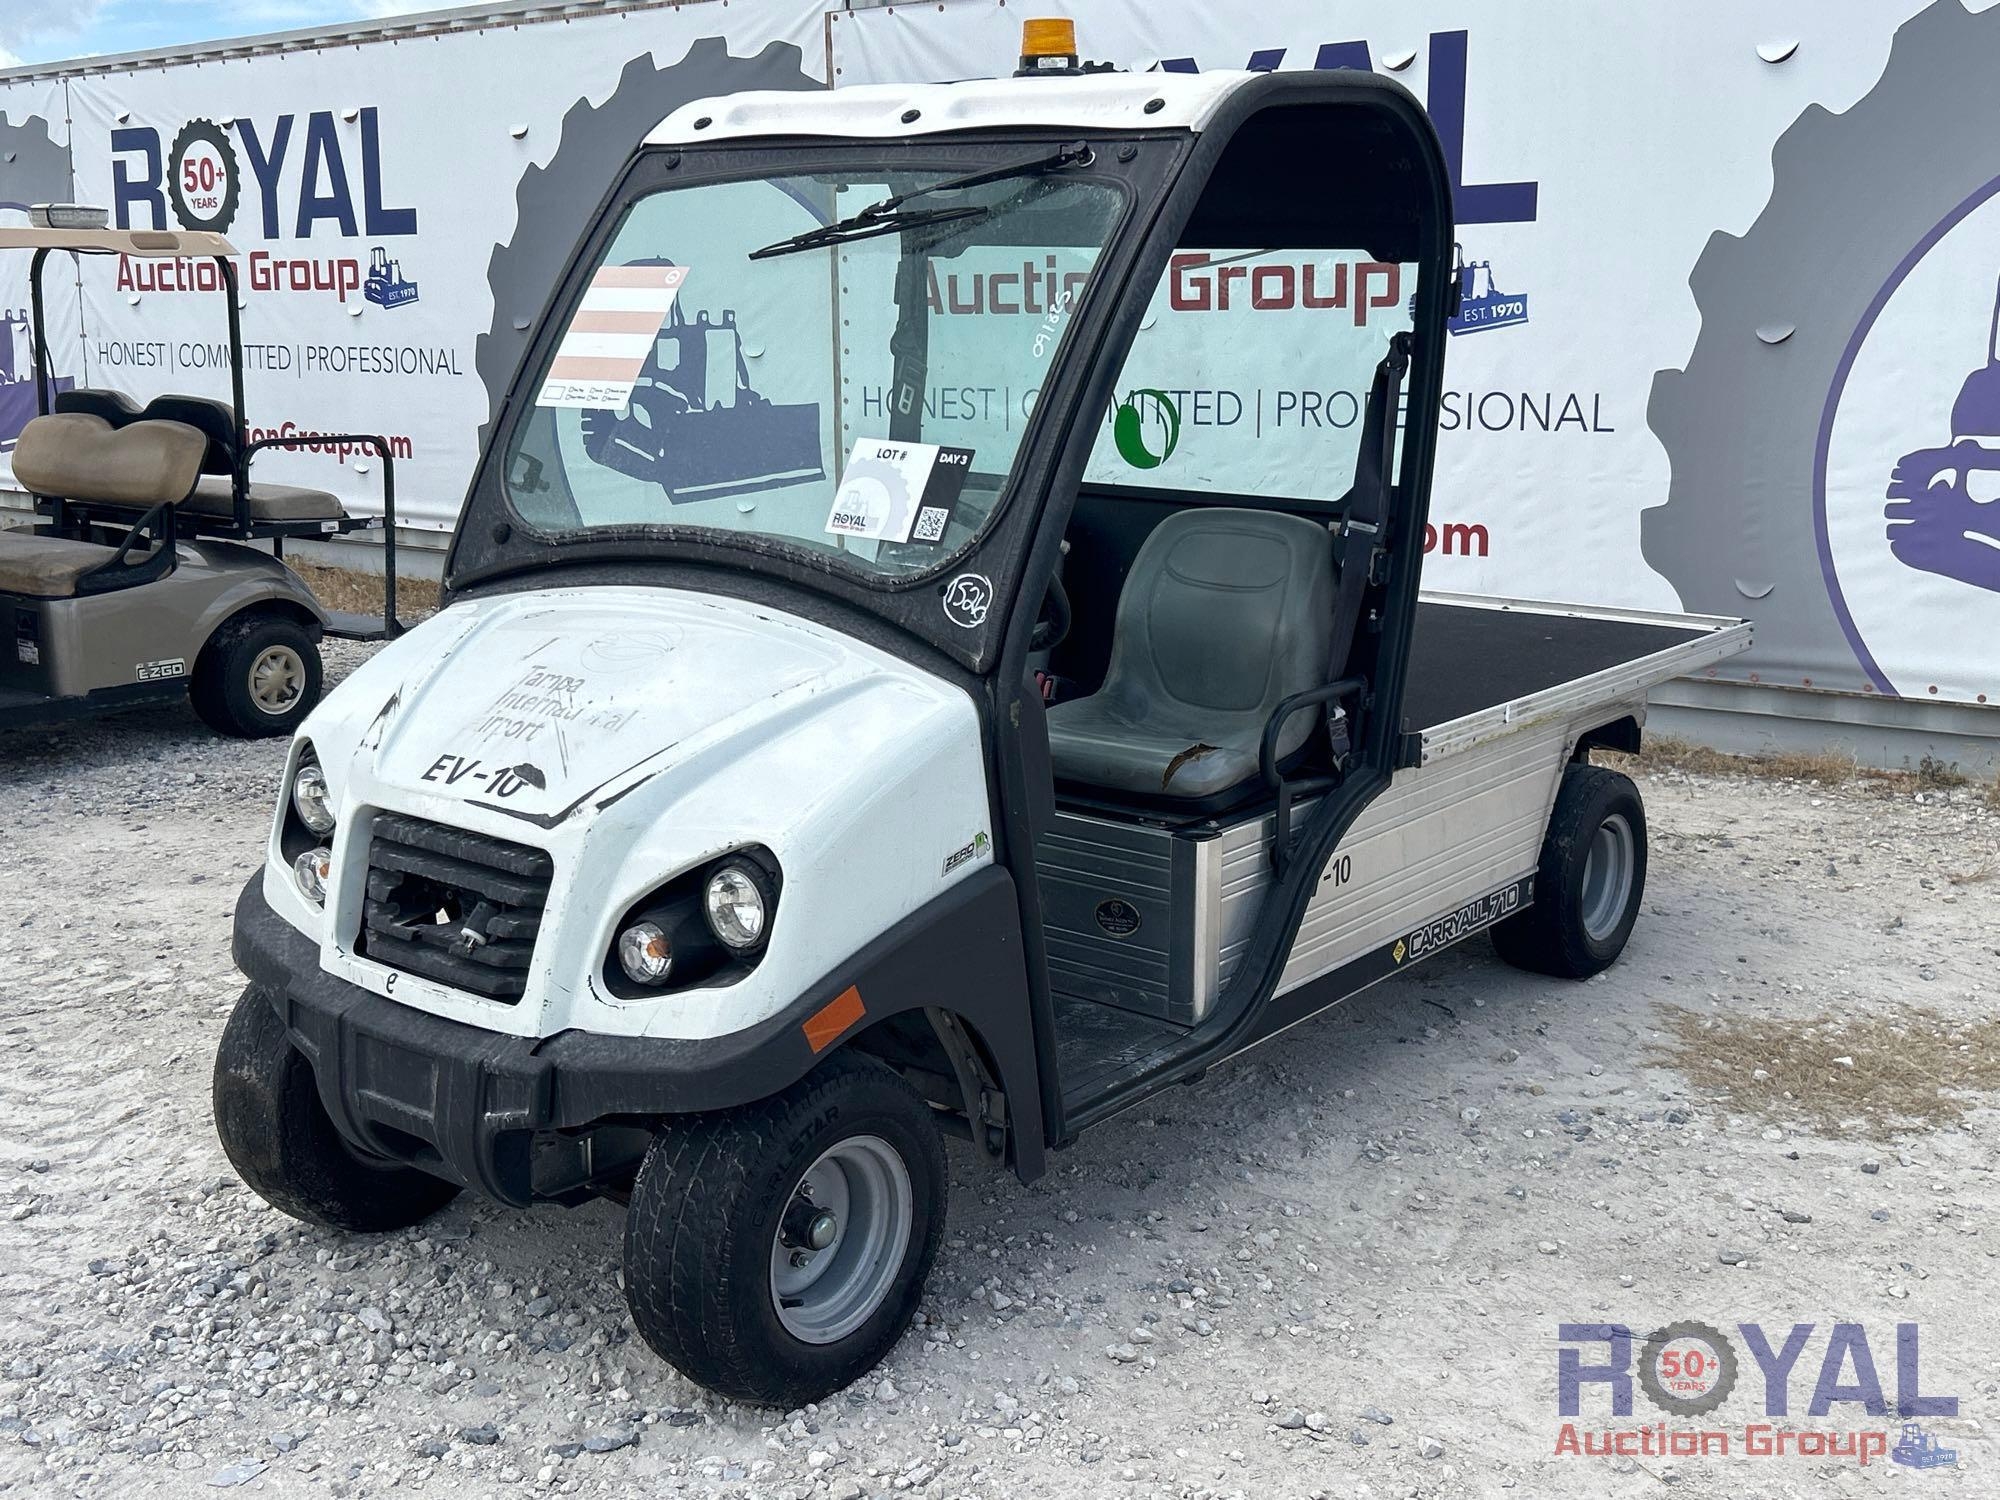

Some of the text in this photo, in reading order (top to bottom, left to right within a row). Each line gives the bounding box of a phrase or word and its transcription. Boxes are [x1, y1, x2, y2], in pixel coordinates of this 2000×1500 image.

[111, 106, 418, 239] ROYAL
[183, 157, 225, 193] 50+
[191, 197, 218, 209] YEARS
[117, 250, 359, 303] Auction Group
[400, 287, 416, 298] 1970
[928, 253, 1401, 327] Auctio Group
[1464, 301, 1523, 322] EST. 1970
[98, 342, 166, 367] HONEST
[306, 345, 463, 376] PROFESSIONAL
[863, 385, 996, 421] HNEST
[877, 448, 908, 462] LOT #
[940, 453, 968, 466] DAY 3
[832, 513, 867, 528] ROYAL
[420, 753, 528, 798] EV-10
[946, 842, 975, 868] ZERO
[1408, 882, 1521, 960] CARRYALL 710
